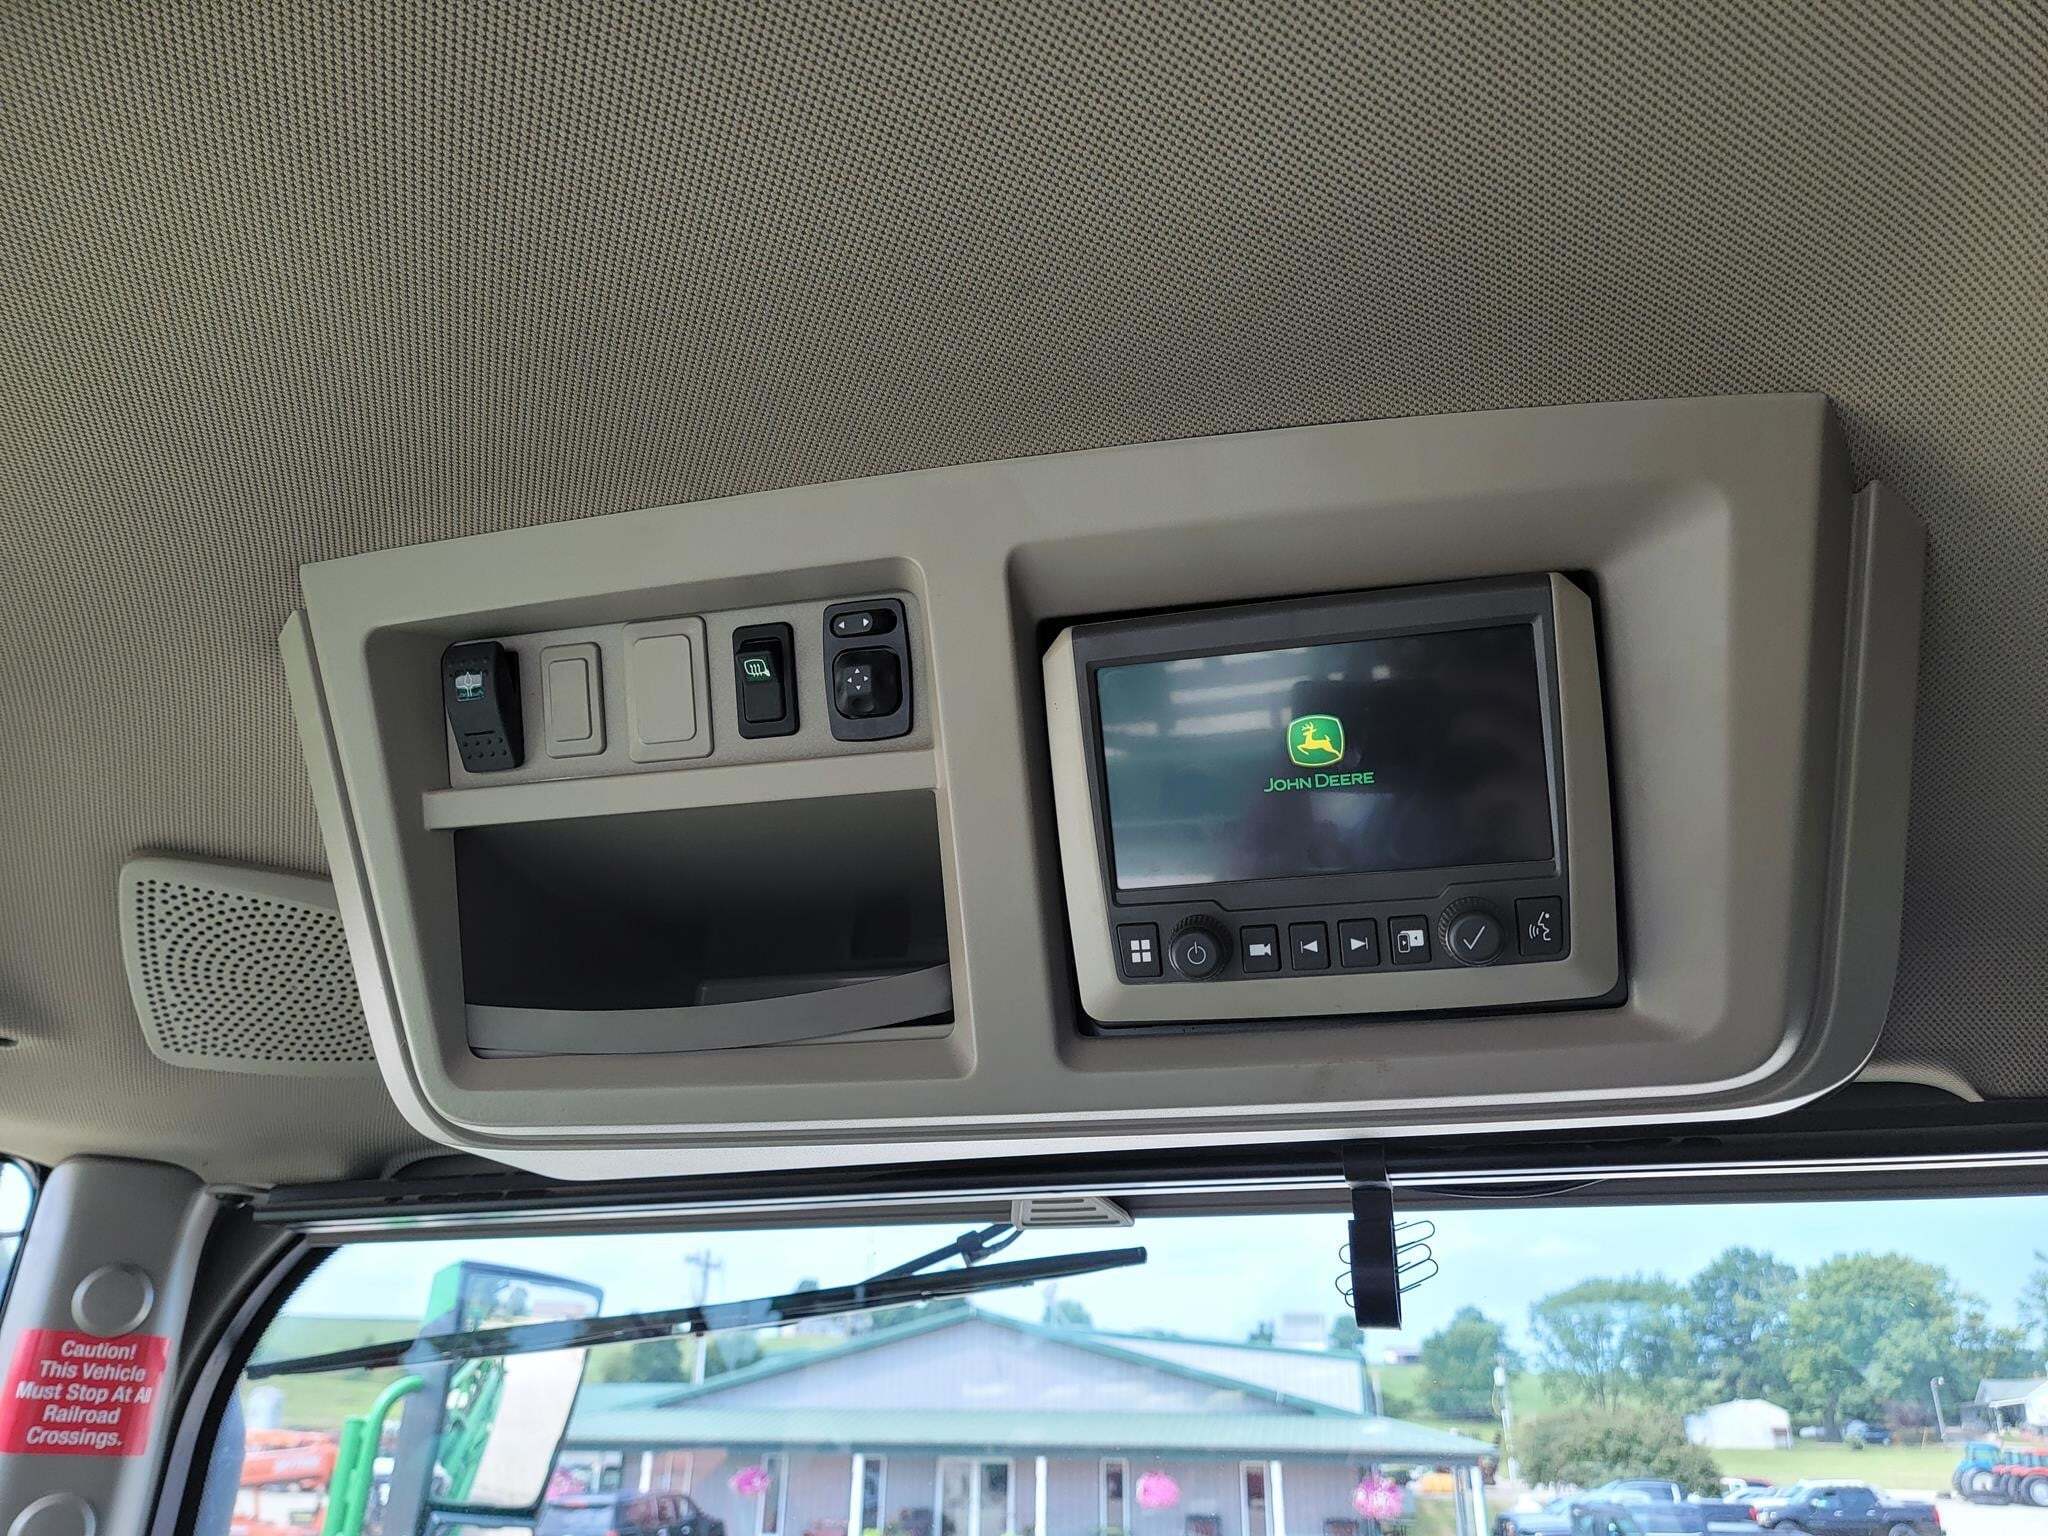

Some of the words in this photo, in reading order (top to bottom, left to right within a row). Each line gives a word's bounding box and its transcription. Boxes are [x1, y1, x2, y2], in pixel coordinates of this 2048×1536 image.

[1263, 777, 1312, 793] JOHN
[1314, 772, 1375, 788] DEERE
[61, 1340, 138, 1360] Caution!
[40, 1360, 79, 1379] This
[83, 1362, 146, 1383] Vehicle
[16, 1381, 61, 1401] Must
[65, 1383, 108, 1404] Stop
[111, 1386, 131, 1402] At
[43, 1404, 121, 1425] Railroad
[26, 1426, 122, 1449] Crossings.
